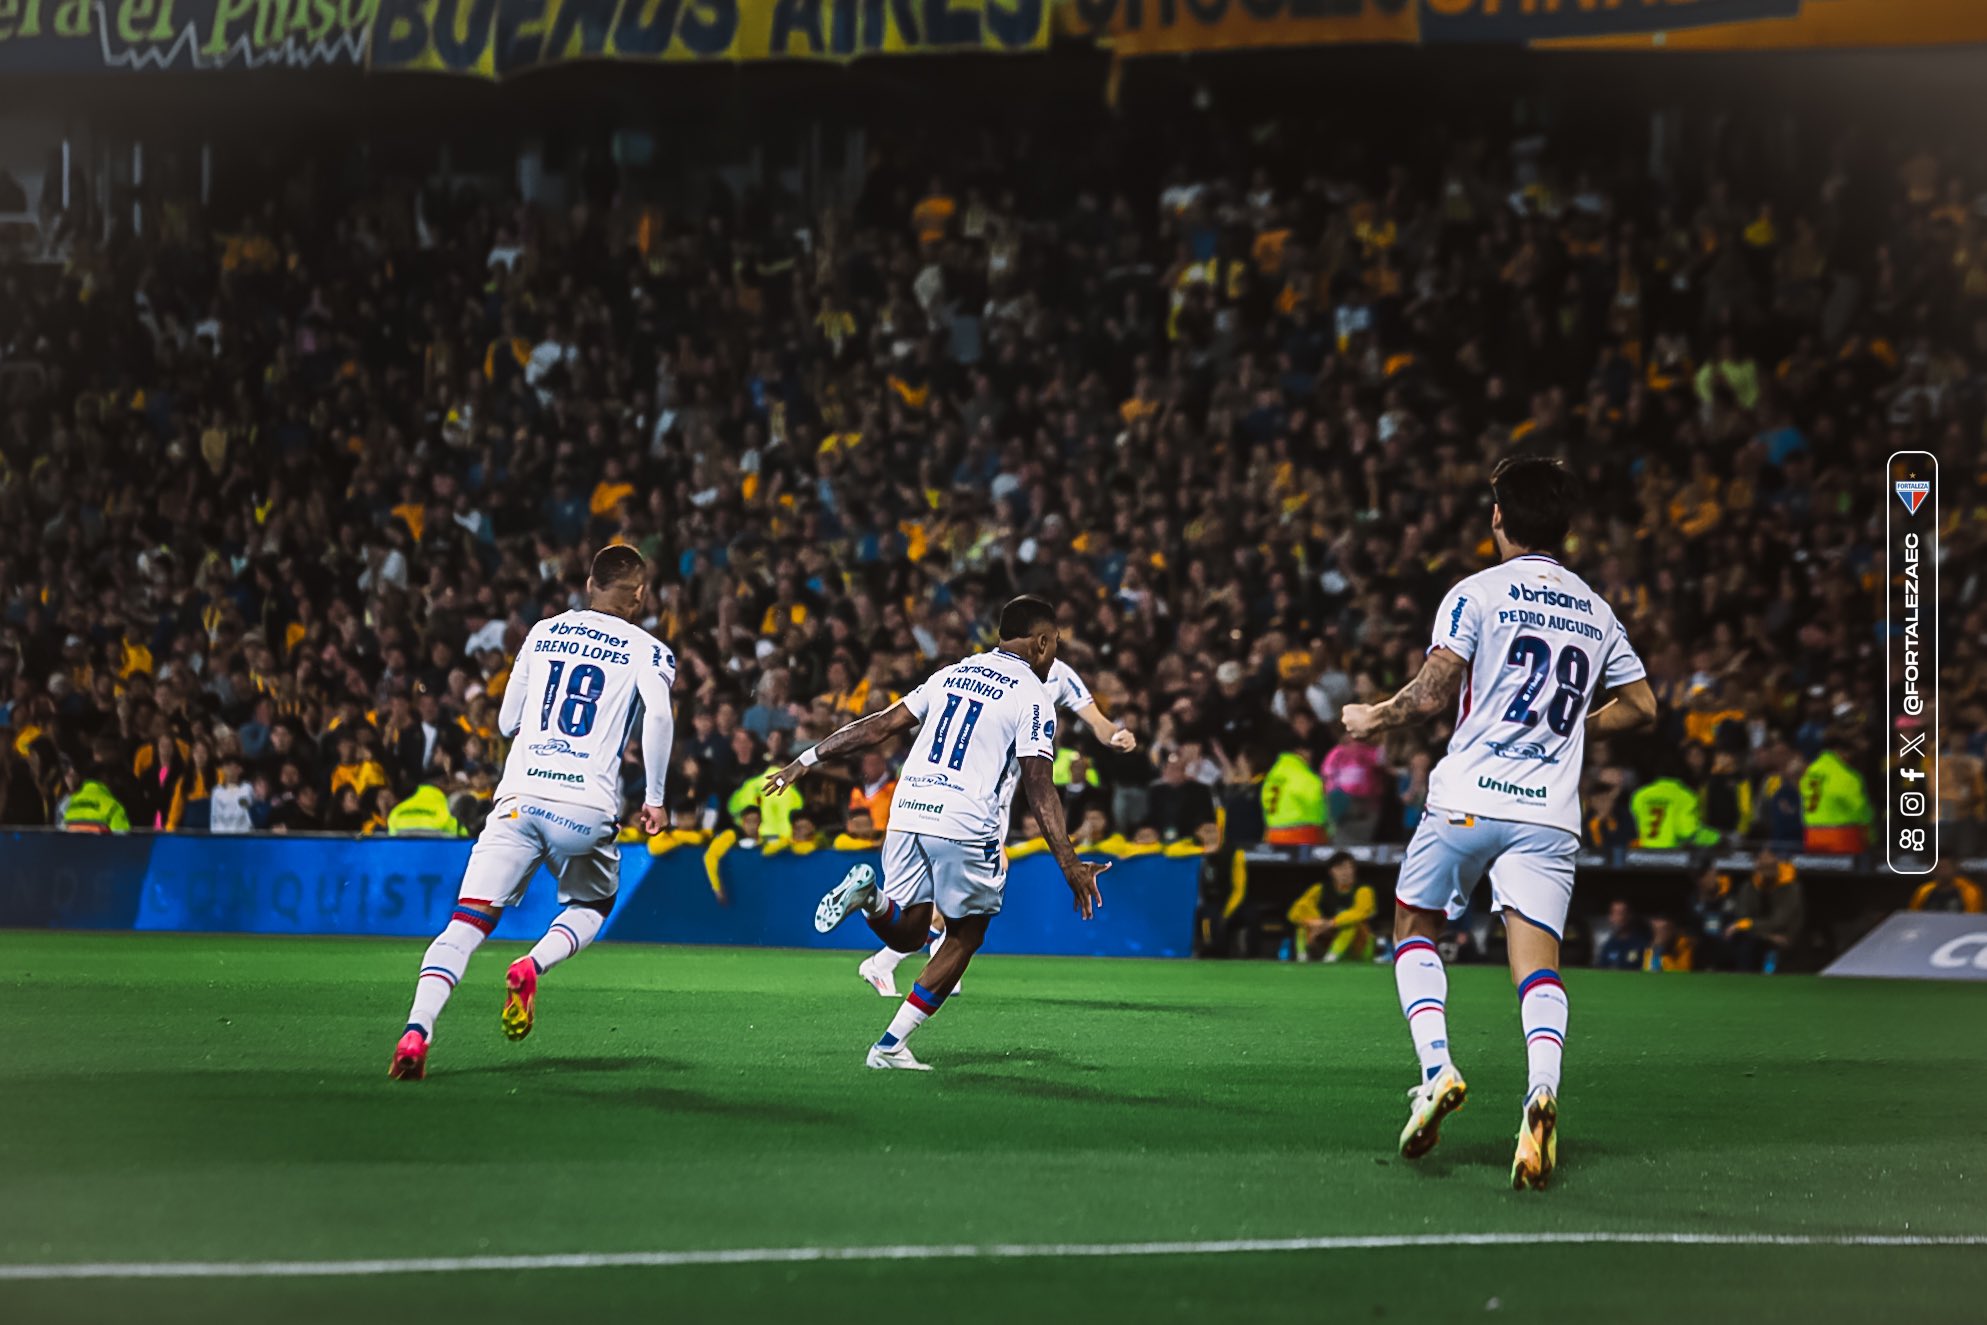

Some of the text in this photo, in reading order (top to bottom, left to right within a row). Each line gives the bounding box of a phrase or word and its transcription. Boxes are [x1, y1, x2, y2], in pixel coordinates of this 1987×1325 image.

[372, 0, 738, 67] BUENOS
[770, 0, 1043, 54] AIRES
[1520, 582, 1593, 616] brisanet
[557, 621, 629, 649] brisanet
[1498, 609, 1546, 627] PEDRO
[1547, 614, 1604, 641] AUGUSTO
[533, 639, 580, 655] BRENO
[581, 644, 631, 665] LOPES
[540, 659, 606, 738] 18
[942, 676, 1004, 701] MARINHO
[1501, 635, 1591, 739] 28
[927, 692, 984, 772] 11
[1030, 703, 1042, 742] novibet
[1478, 775, 1548, 799] Unimed
[520, 804, 593, 837] COMBUSTÍVEIS
[898, 798, 944, 815] Unimed
